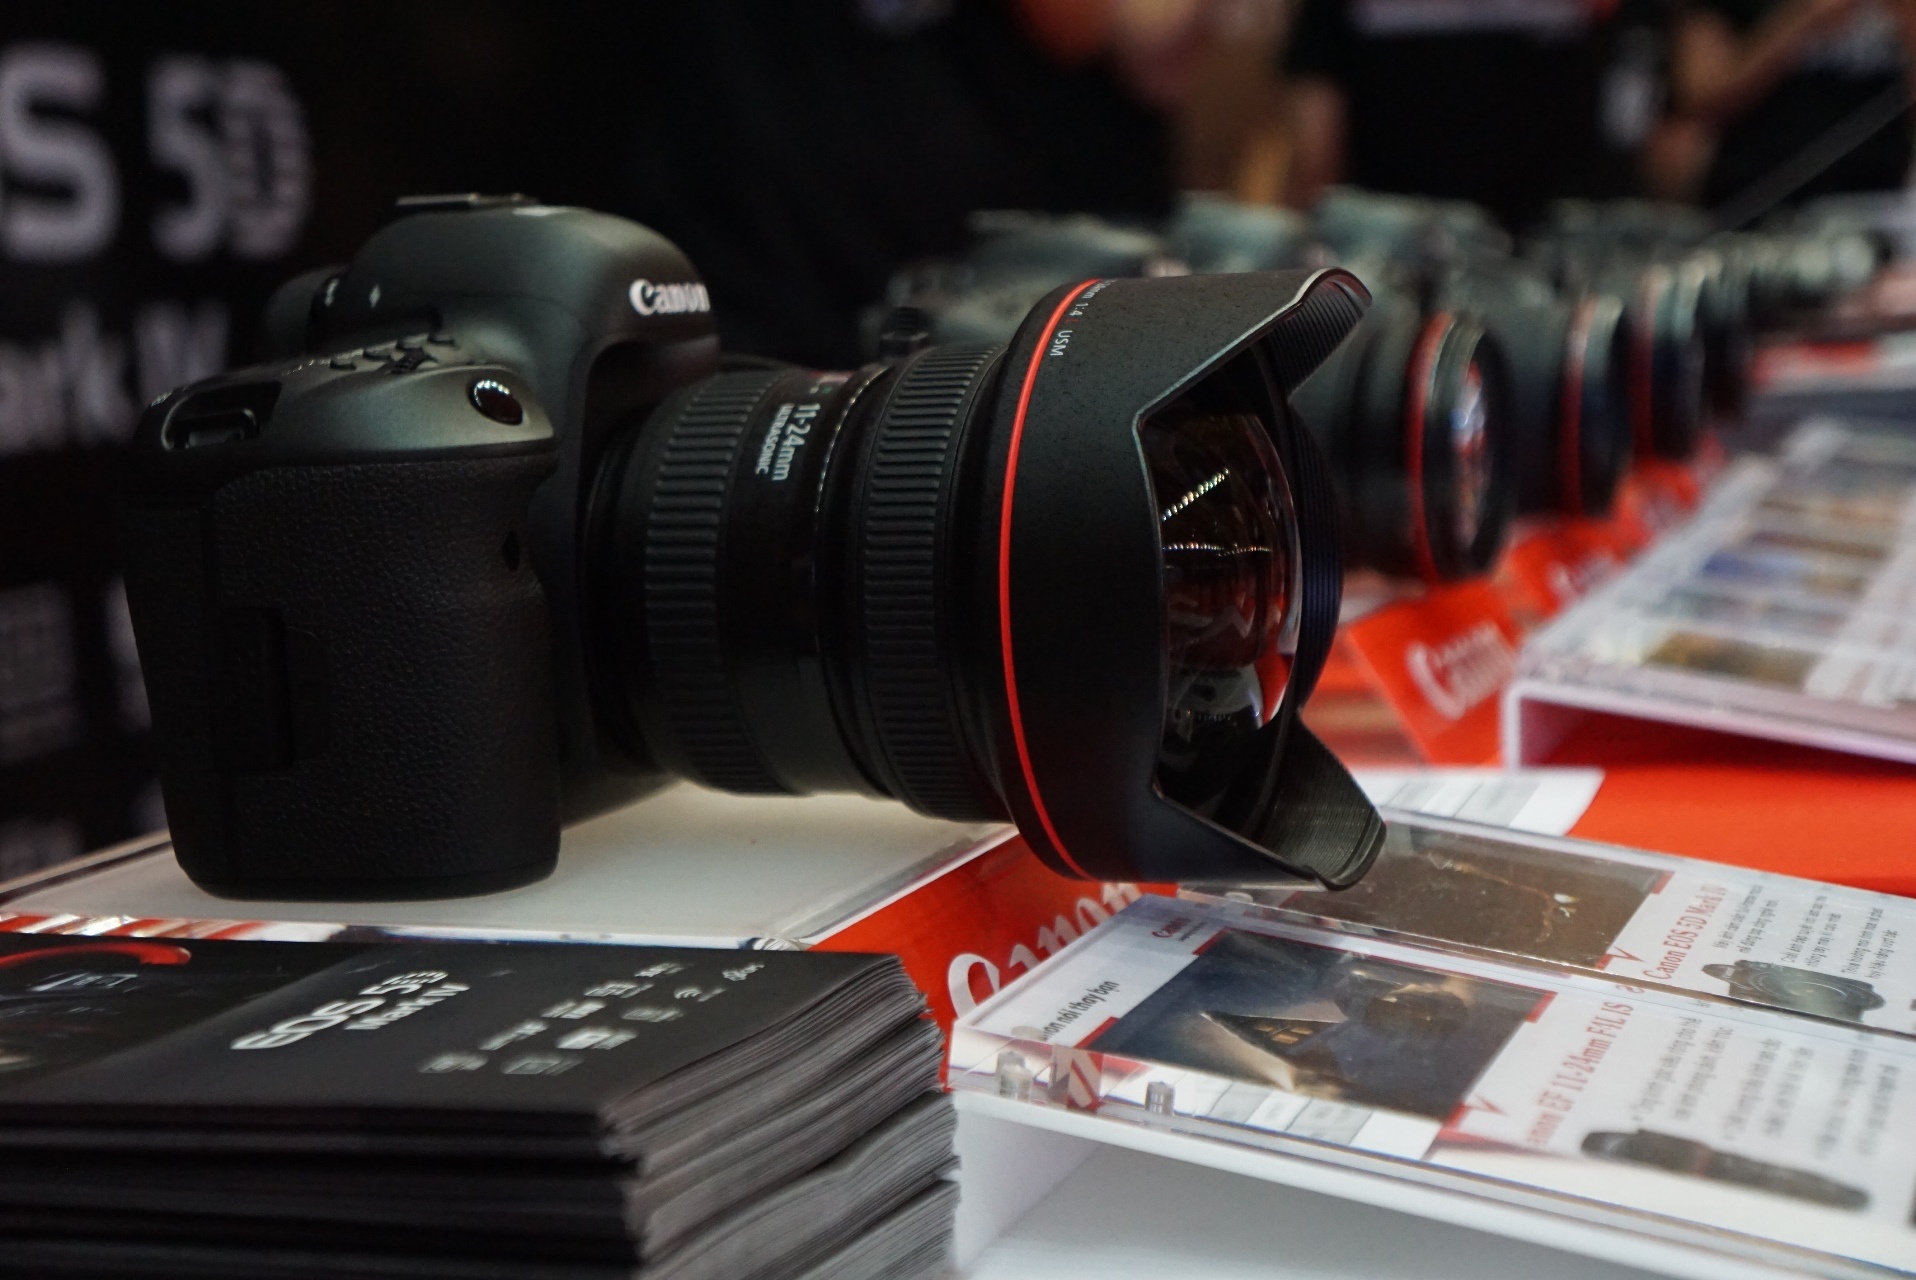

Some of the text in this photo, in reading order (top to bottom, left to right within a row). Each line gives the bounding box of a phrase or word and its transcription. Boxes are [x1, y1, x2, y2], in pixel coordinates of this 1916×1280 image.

[629, 279, 711, 316] Canon
[1069, 302, 1089, 316] 1:4
[1049, 329, 1074, 356] USM
[755, 402, 796, 475] ULTRASONIC
[771, 402, 821, 481] 11-24mm
[1663, 929, 1699, 950] EOS
[1676, 916, 1708, 930] 5D
[1642, 950, 1688, 980] Canon
[229, 971, 449, 1050] EOS 5D
[1550, 1038, 1613, 1093] 11-24mm
